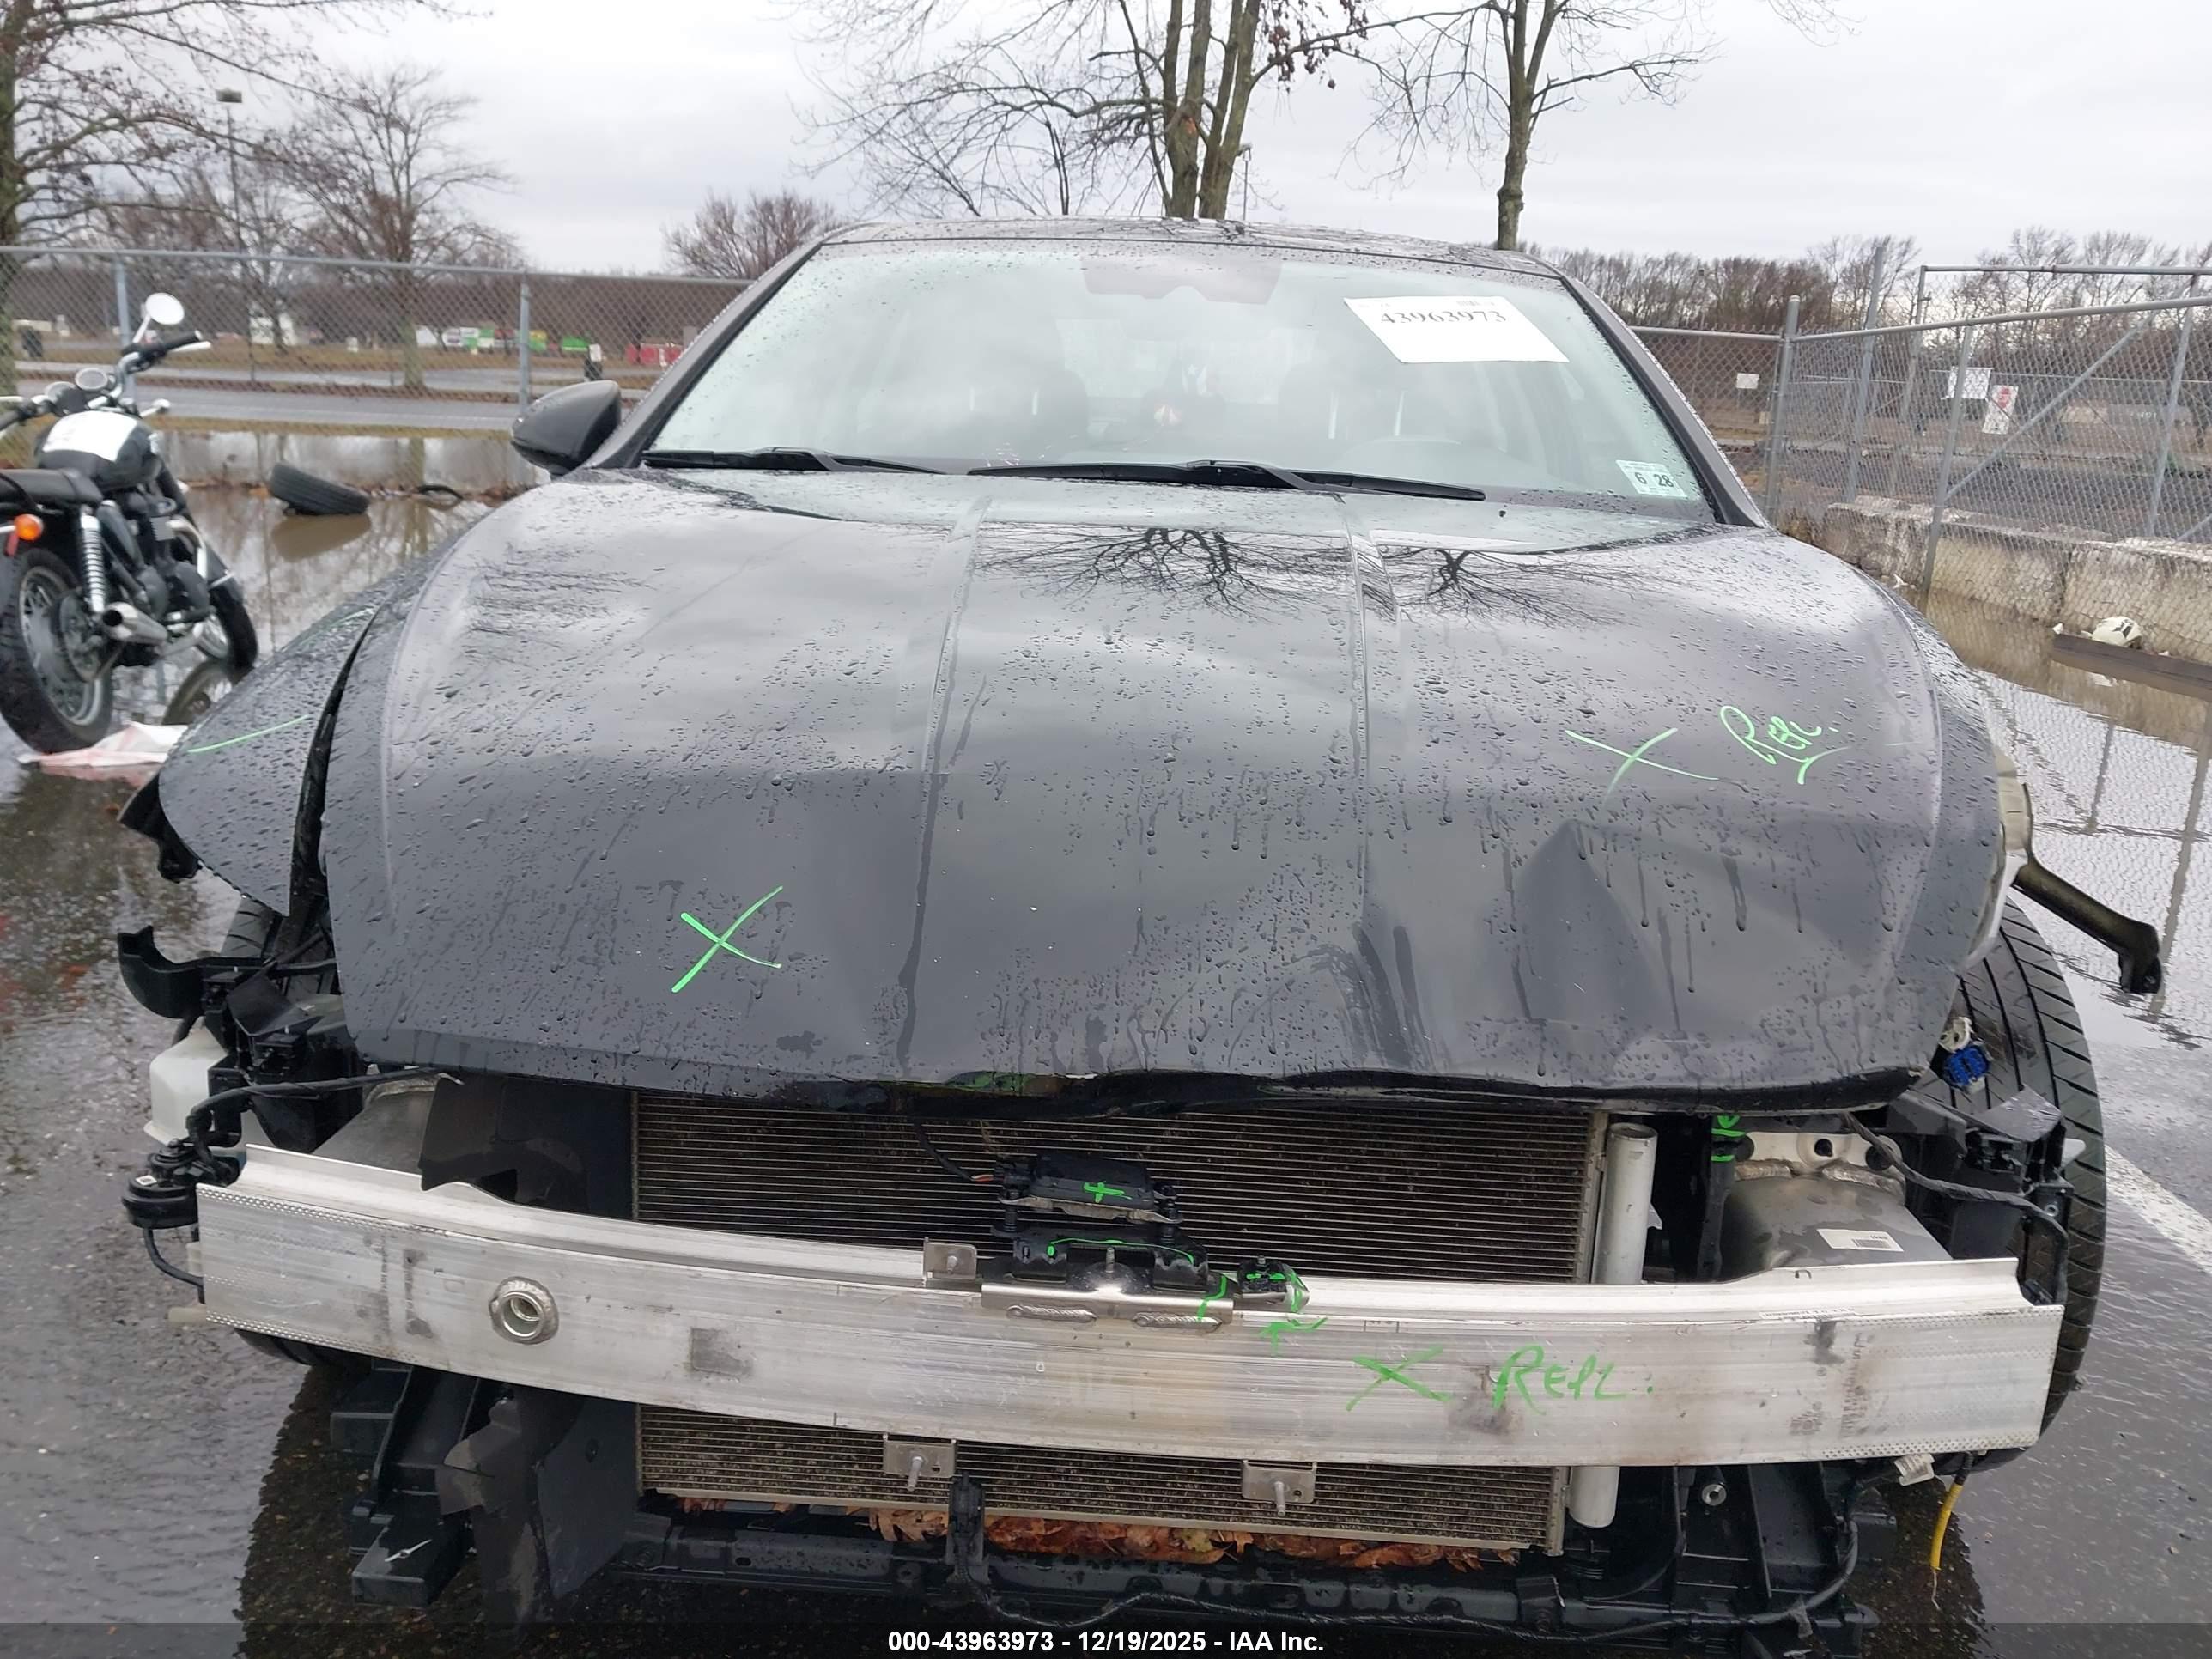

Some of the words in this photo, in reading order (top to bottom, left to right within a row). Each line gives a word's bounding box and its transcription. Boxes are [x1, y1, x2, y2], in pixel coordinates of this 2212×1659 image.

[1381, 310, 1507, 324] 43963973
[1634, 471, 1648, 485] 6
[1653, 473, 1674, 488] 28
